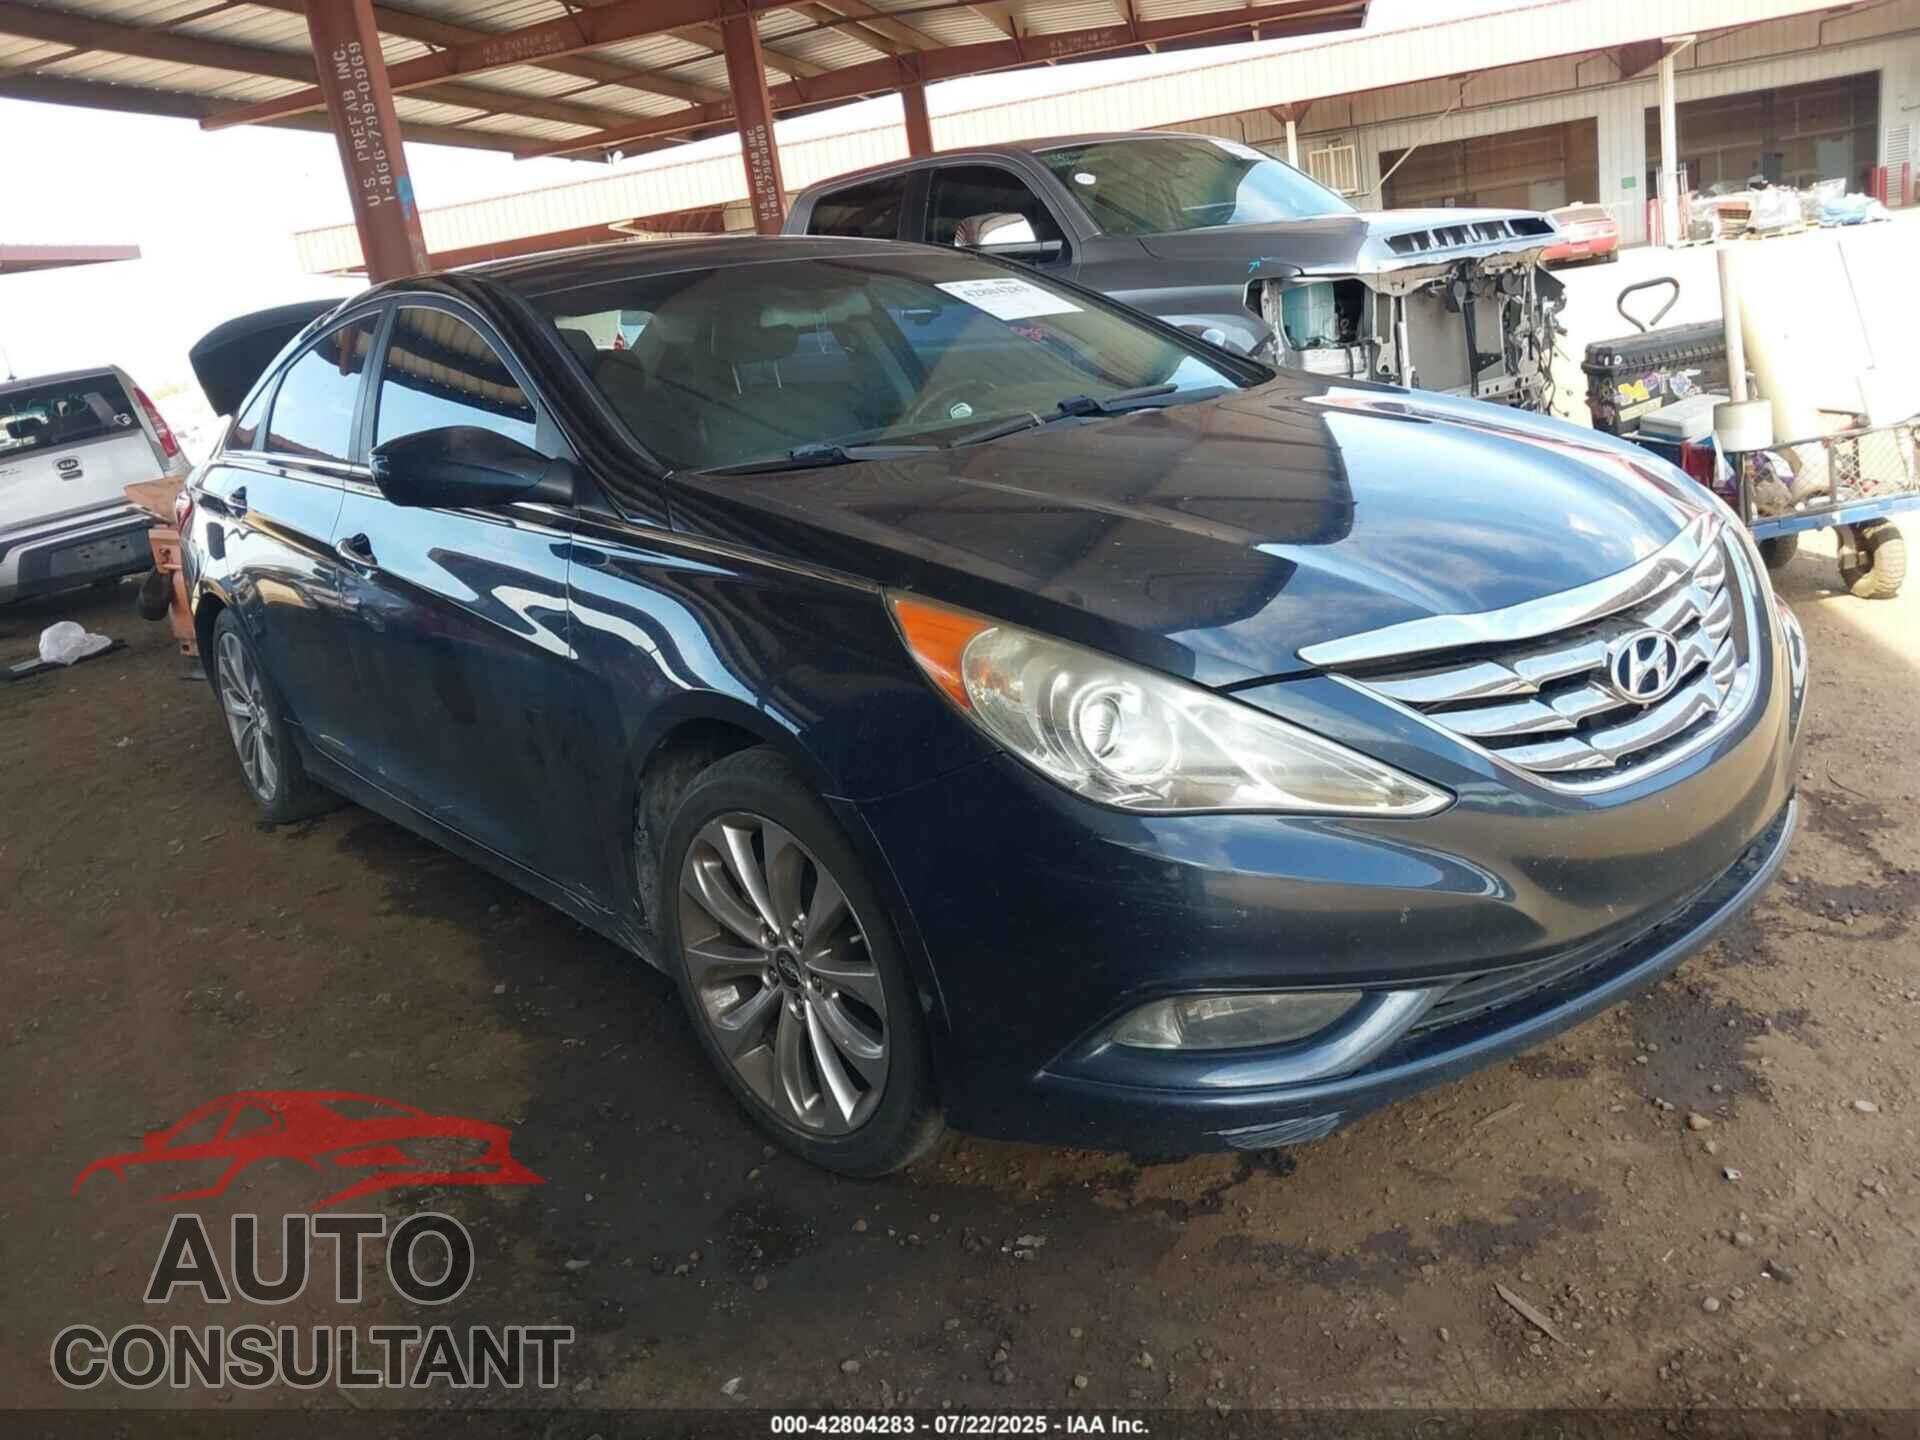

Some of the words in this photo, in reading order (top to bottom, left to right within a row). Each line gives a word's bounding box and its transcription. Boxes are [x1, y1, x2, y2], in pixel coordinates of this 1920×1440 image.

[333, 42, 352, 80] INC.
[343, 90, 370, 162] PREFAB
[364, 172, 380, 207] U.S.
